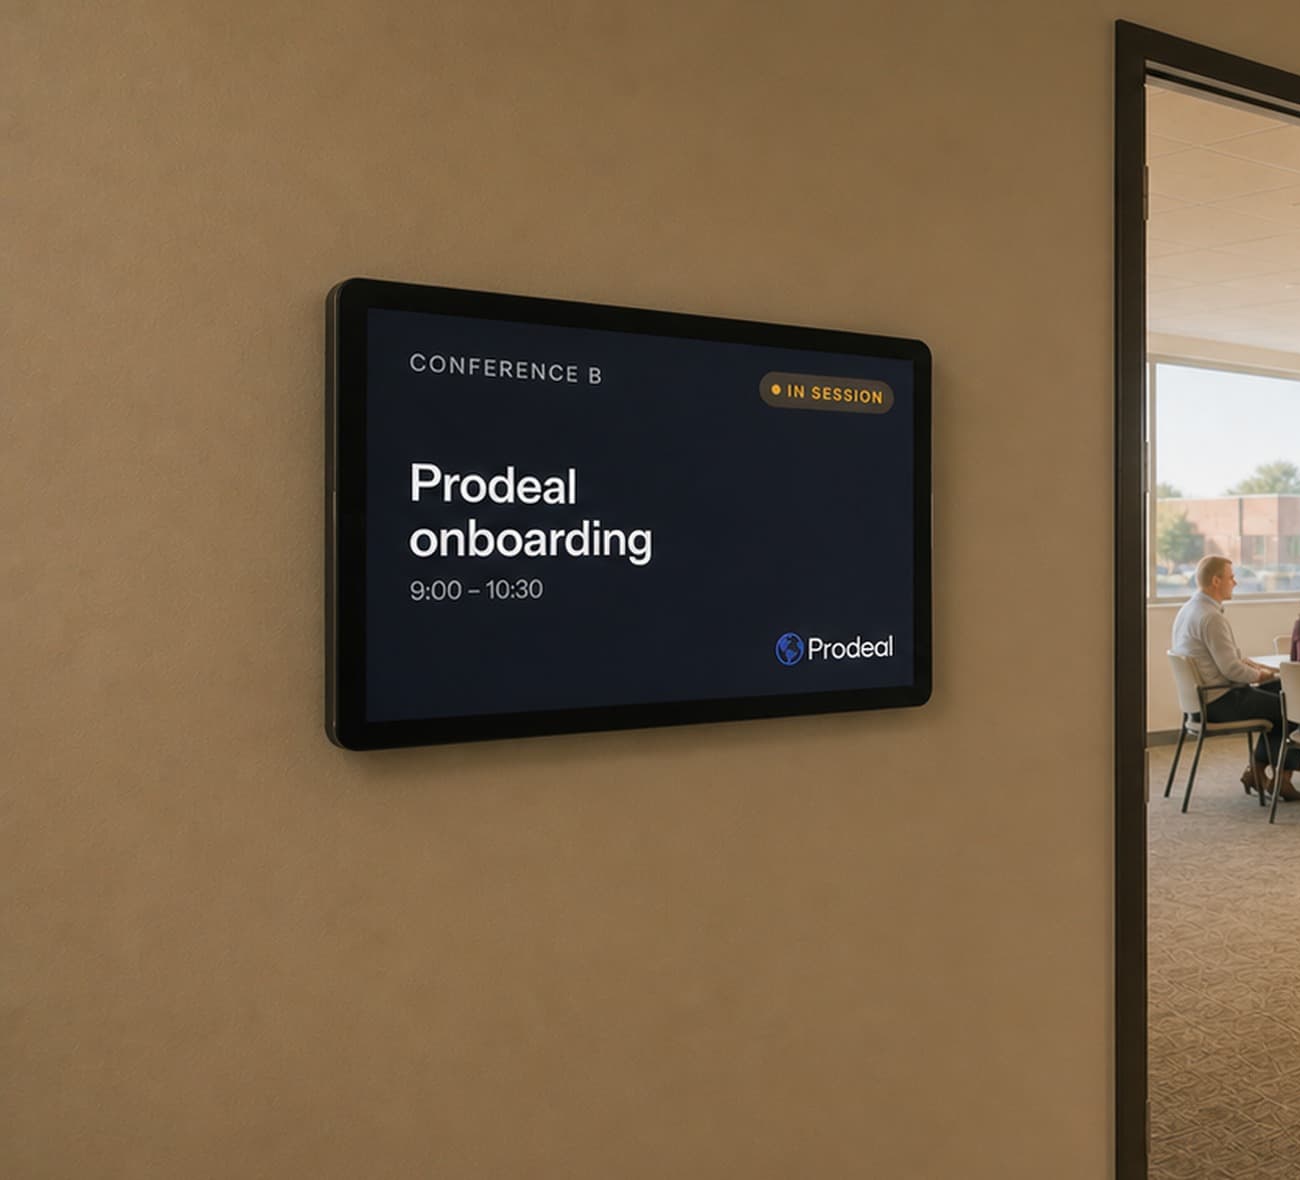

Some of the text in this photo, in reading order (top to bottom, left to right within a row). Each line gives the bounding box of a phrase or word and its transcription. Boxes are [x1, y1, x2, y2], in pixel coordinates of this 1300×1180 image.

[409, 353, 602, 385] CONFERENCE B
[787, 384, 883, 404] IN SESSION
[411, 462, 576, 505] Prodeal
[409, 518, 652, 566] onboarding
[410, 579, 462, 601] 9:00
[485, 578, 544, 600] 10:30
[808, 634, 893, 660] Prodeal
